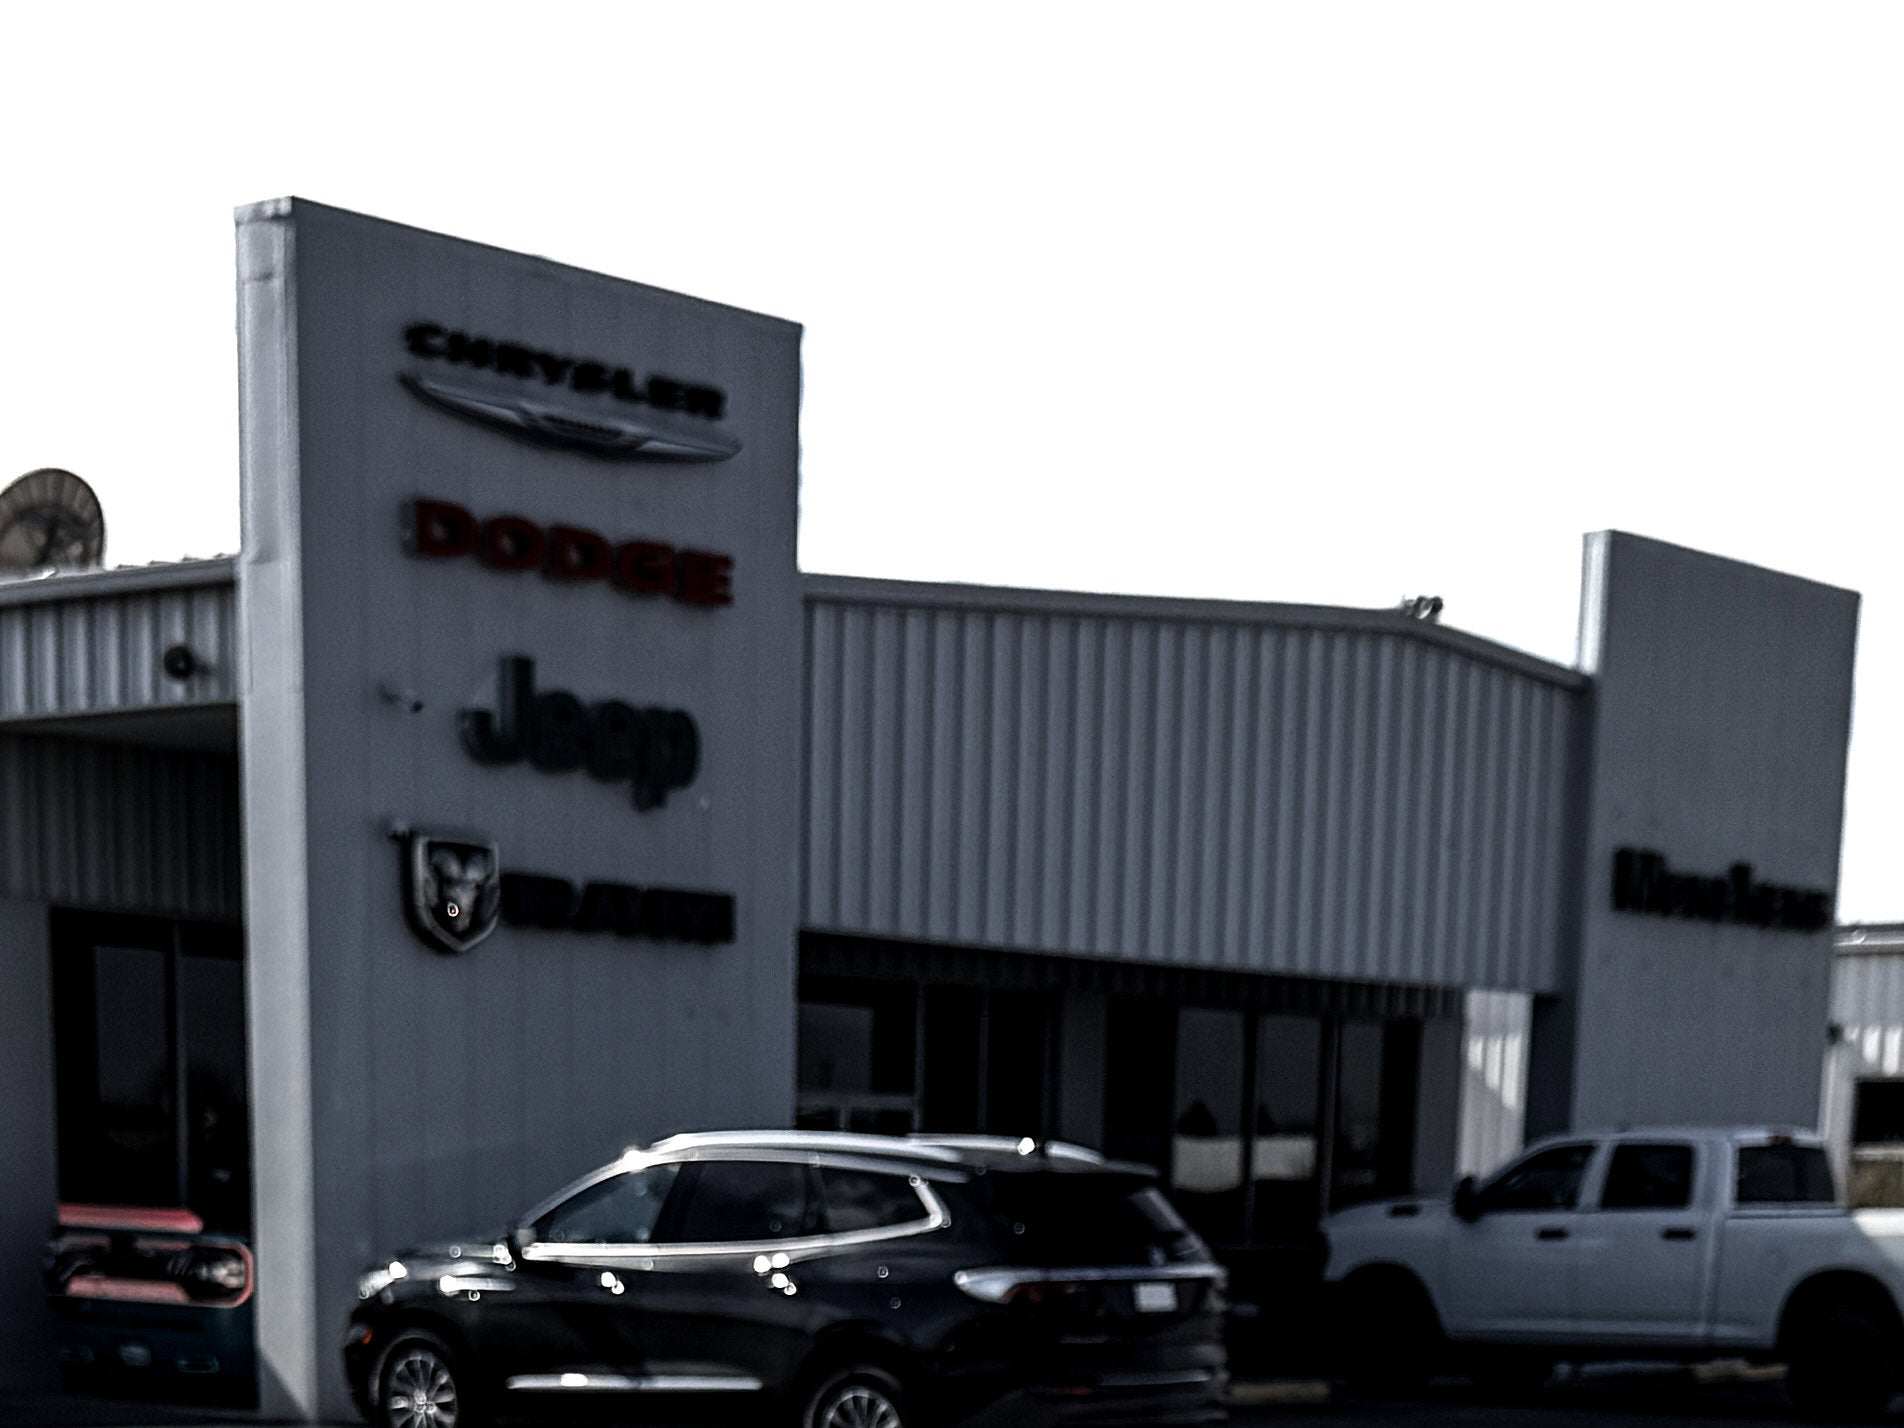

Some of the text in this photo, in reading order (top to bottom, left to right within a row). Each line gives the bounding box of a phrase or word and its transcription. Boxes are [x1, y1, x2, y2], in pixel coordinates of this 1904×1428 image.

[405, 323, 726, 418] CHRYSLER
[405, 499, 734, 607] DODGE
[462, 655, 701, 810] Jeep
